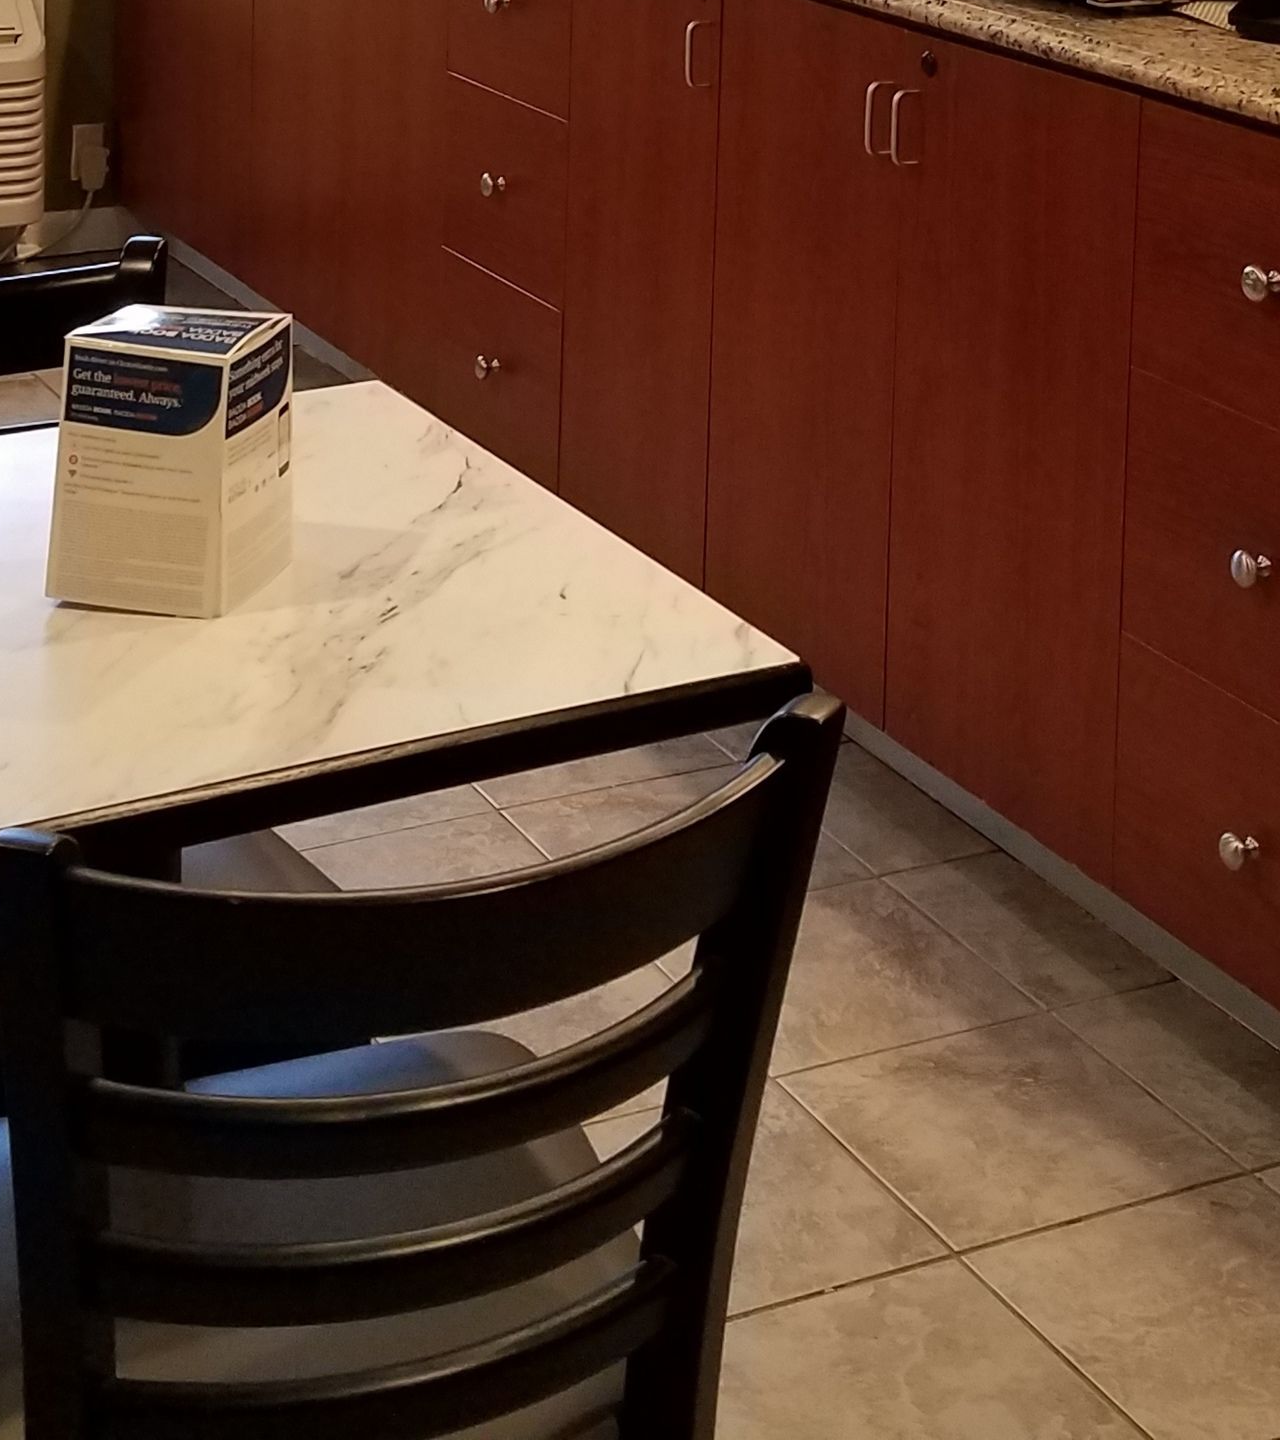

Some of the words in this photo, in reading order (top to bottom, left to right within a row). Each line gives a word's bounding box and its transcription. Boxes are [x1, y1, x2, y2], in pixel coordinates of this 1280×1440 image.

[73, 368, 92, 381] Get
[94, 370, 112, 383] the
[71, 384, 137, 403] guaranteed.
[138, 392, 182, 409] Always.
